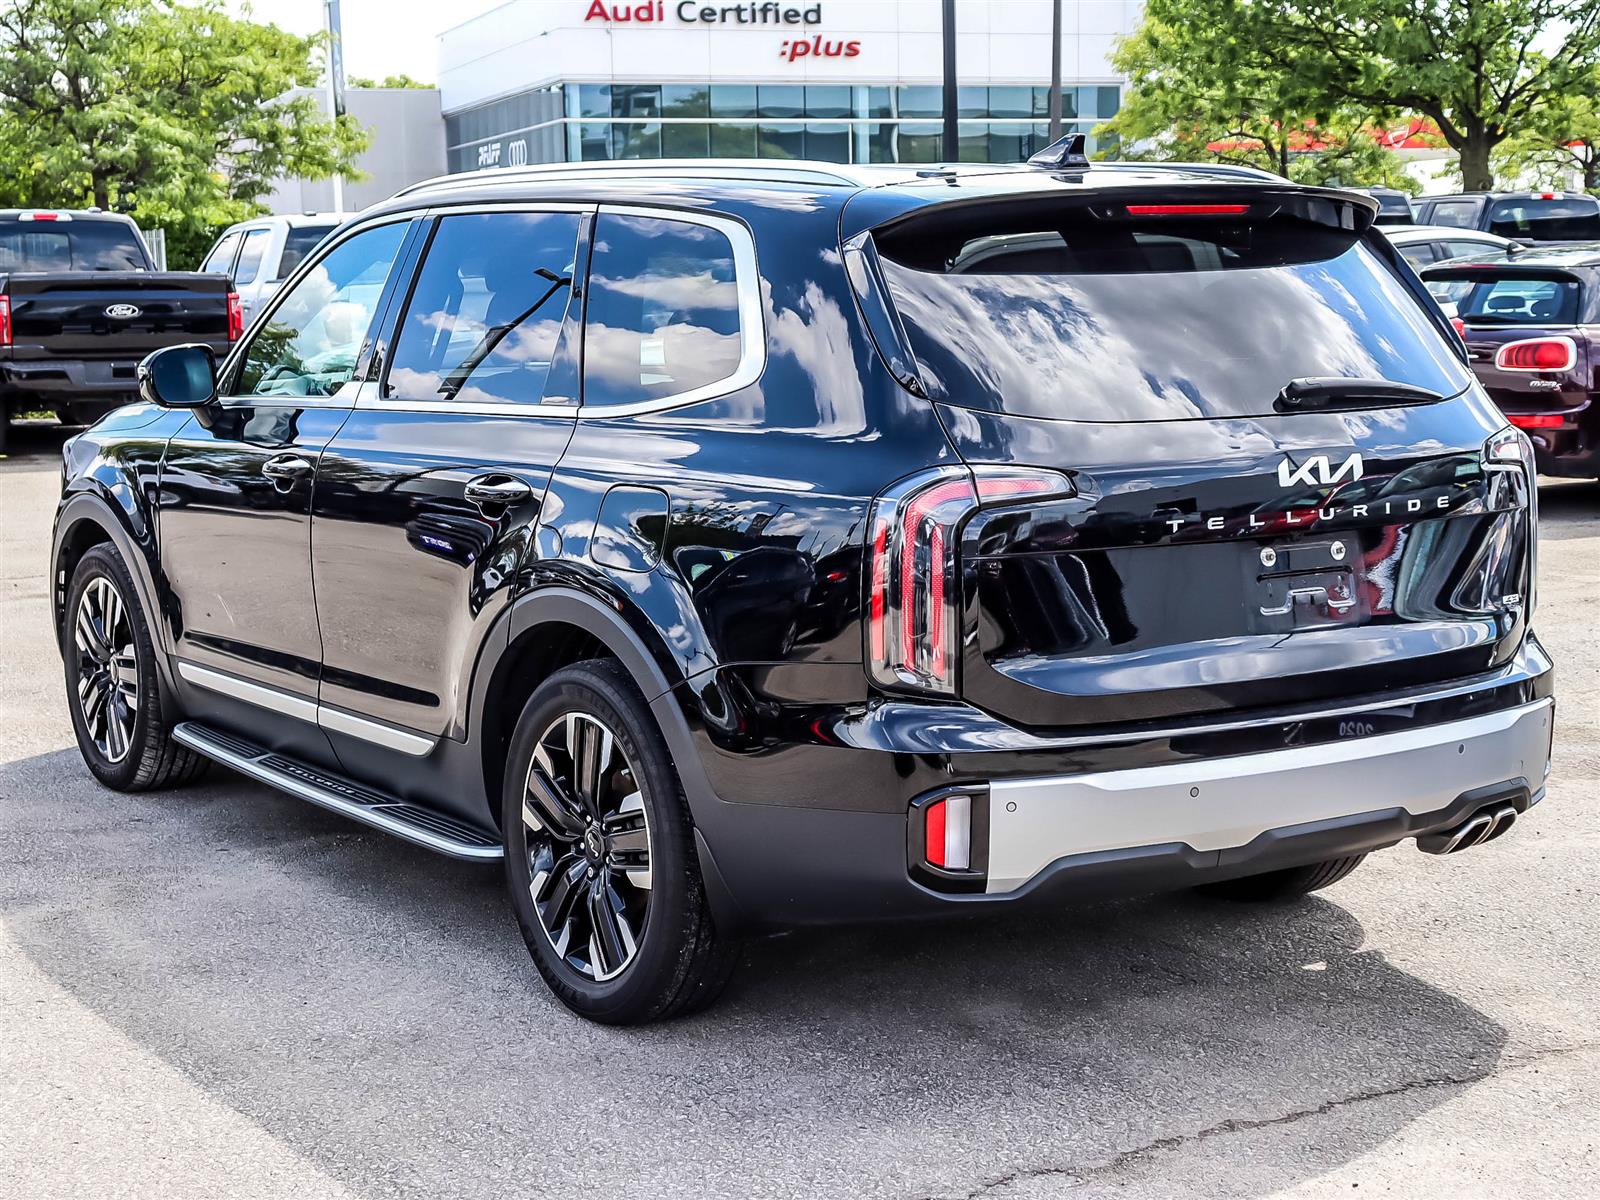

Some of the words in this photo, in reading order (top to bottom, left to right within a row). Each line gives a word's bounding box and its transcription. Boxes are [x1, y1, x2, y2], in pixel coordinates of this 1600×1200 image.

[584, 0, 664, 22] Audi
[677, 1, 822, 25] Certified
[779, 35, 861, 62] :plus
[1278, 453, 1363, 487] KIA
[1165, 495, 1450, 533] TELLURIDE
[288, 767, 355, 794] TELLURIDE
